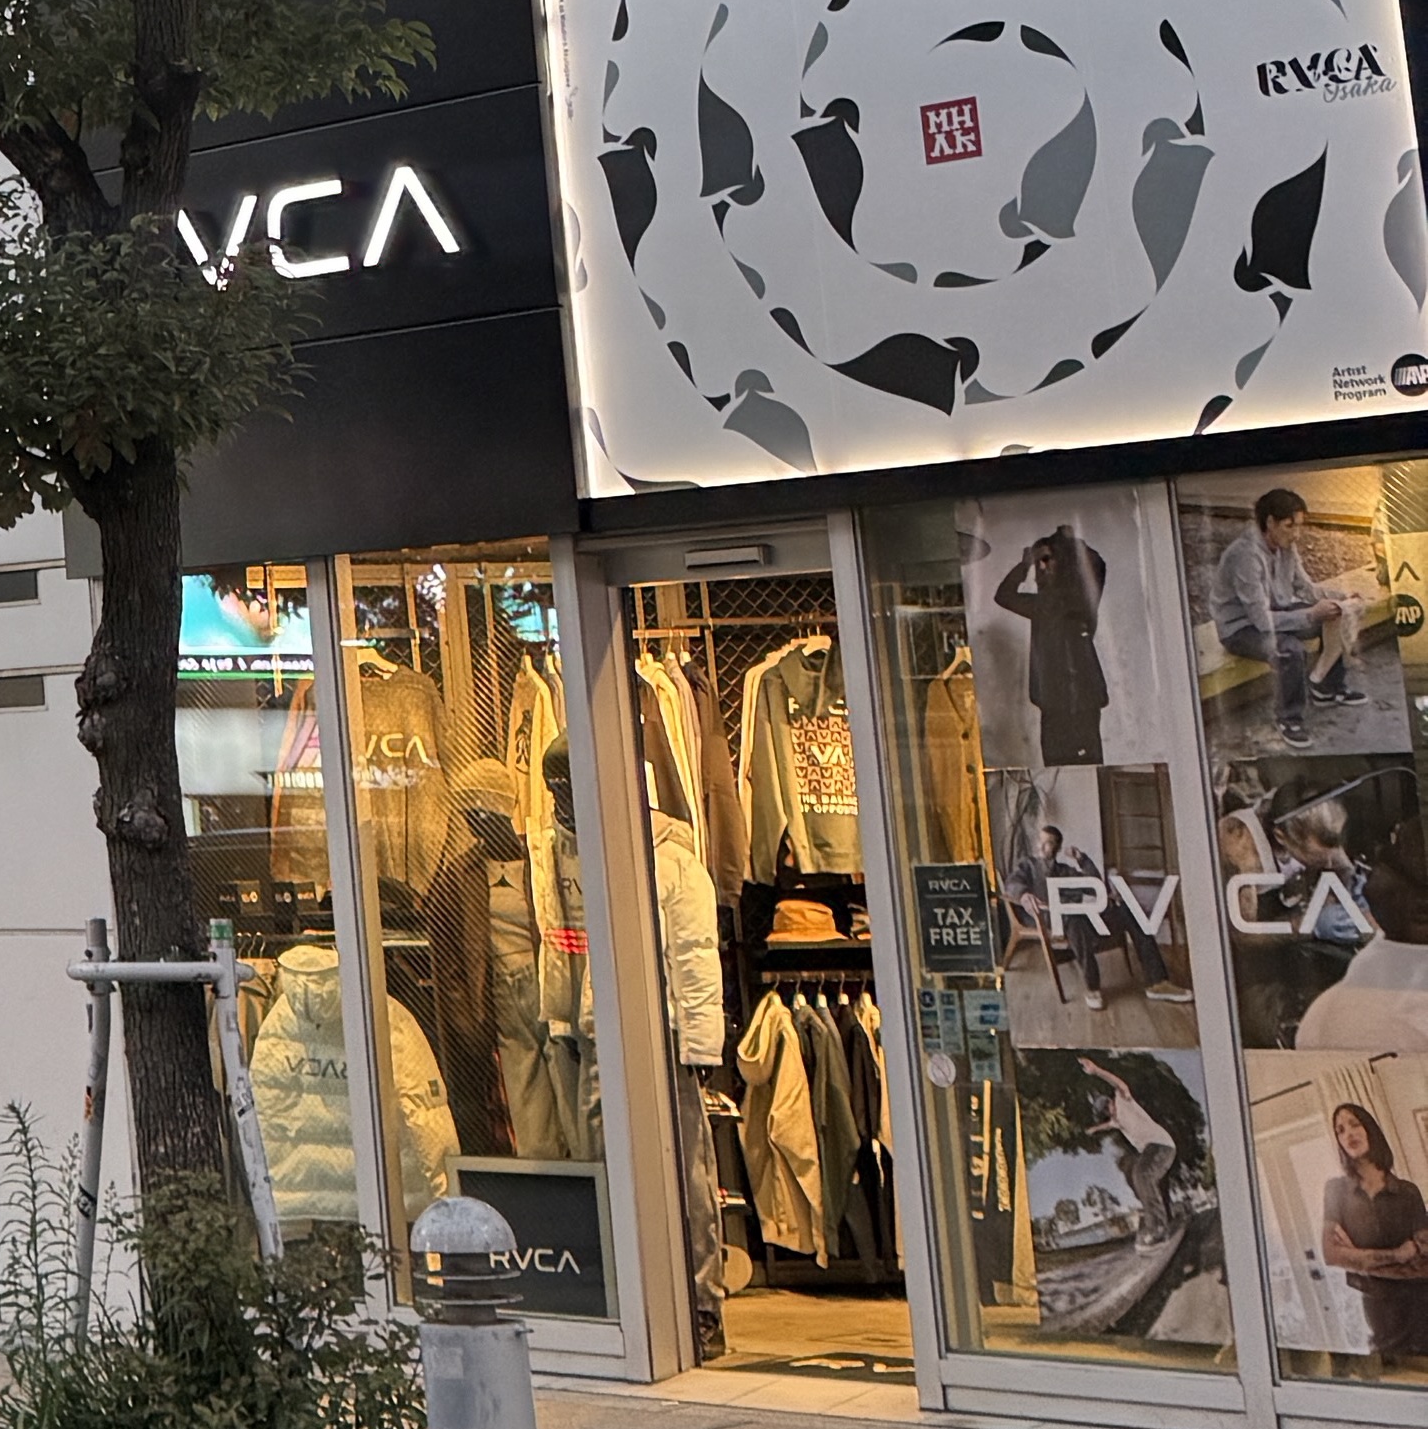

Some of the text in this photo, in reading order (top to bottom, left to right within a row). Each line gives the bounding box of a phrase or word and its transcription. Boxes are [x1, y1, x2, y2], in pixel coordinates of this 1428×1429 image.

[1257, 44, 1387, 97] RVCA
[178, 166, 461, 291] VCA
[1332, 365, 1366, 378] Artist
[1333, 375, 1385, 390] Network
[1334, 388, 1386, 402] Program
[928, 879, 971, 891] RVCA
[933, 907, 974, 926] TAX
[929, 927, 983, 946] FREE
[489, 1247, 581, 1275] RVCA
